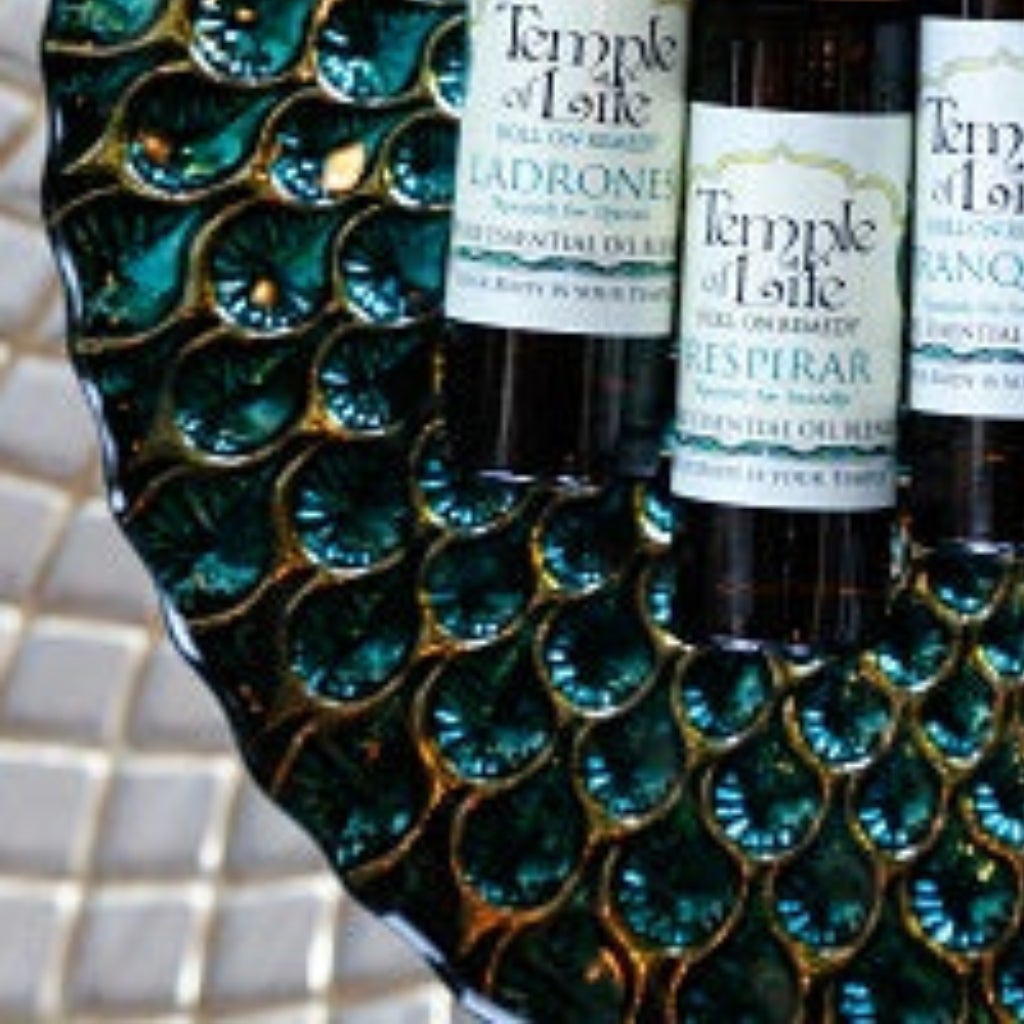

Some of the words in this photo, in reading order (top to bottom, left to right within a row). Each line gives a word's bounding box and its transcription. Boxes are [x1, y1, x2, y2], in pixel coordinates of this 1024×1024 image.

[495, 1, 678, 87] Temple
[503, 76, 534, 111] of
[542, 66, 652, 128] Life
[931, 170, 957, 206] of
[695, 188, 877, 272] Temple
[702, 257, 733, 296] of
[735, 253, 848, 311] Life
[682, 337, 873, 384] RESPIRAR
